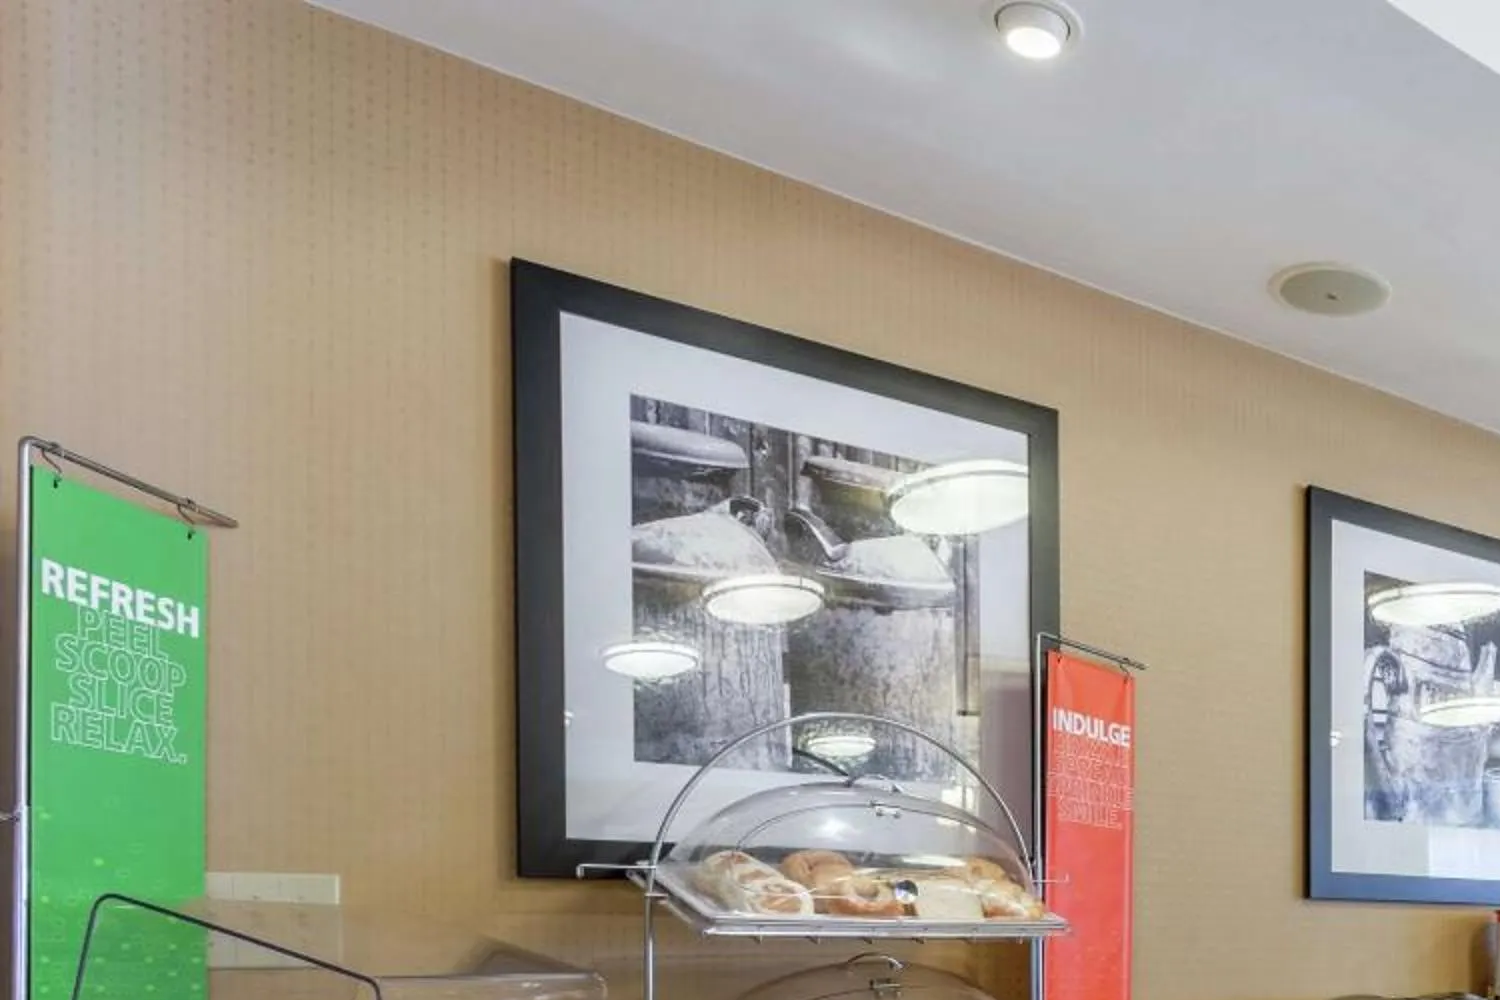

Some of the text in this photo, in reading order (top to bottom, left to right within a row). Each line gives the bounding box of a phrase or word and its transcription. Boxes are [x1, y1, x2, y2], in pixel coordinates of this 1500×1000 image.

[41, 558, 200, 639] REFRESH
[77, 605, 168, 662] PEEL
[55, 633, 186, 695] SCOOP
[69, 671, 173, 727] SLICE
[1052, 706, 1132, 749] INDULGE
[51, 702, 187, 764] RELAX.
